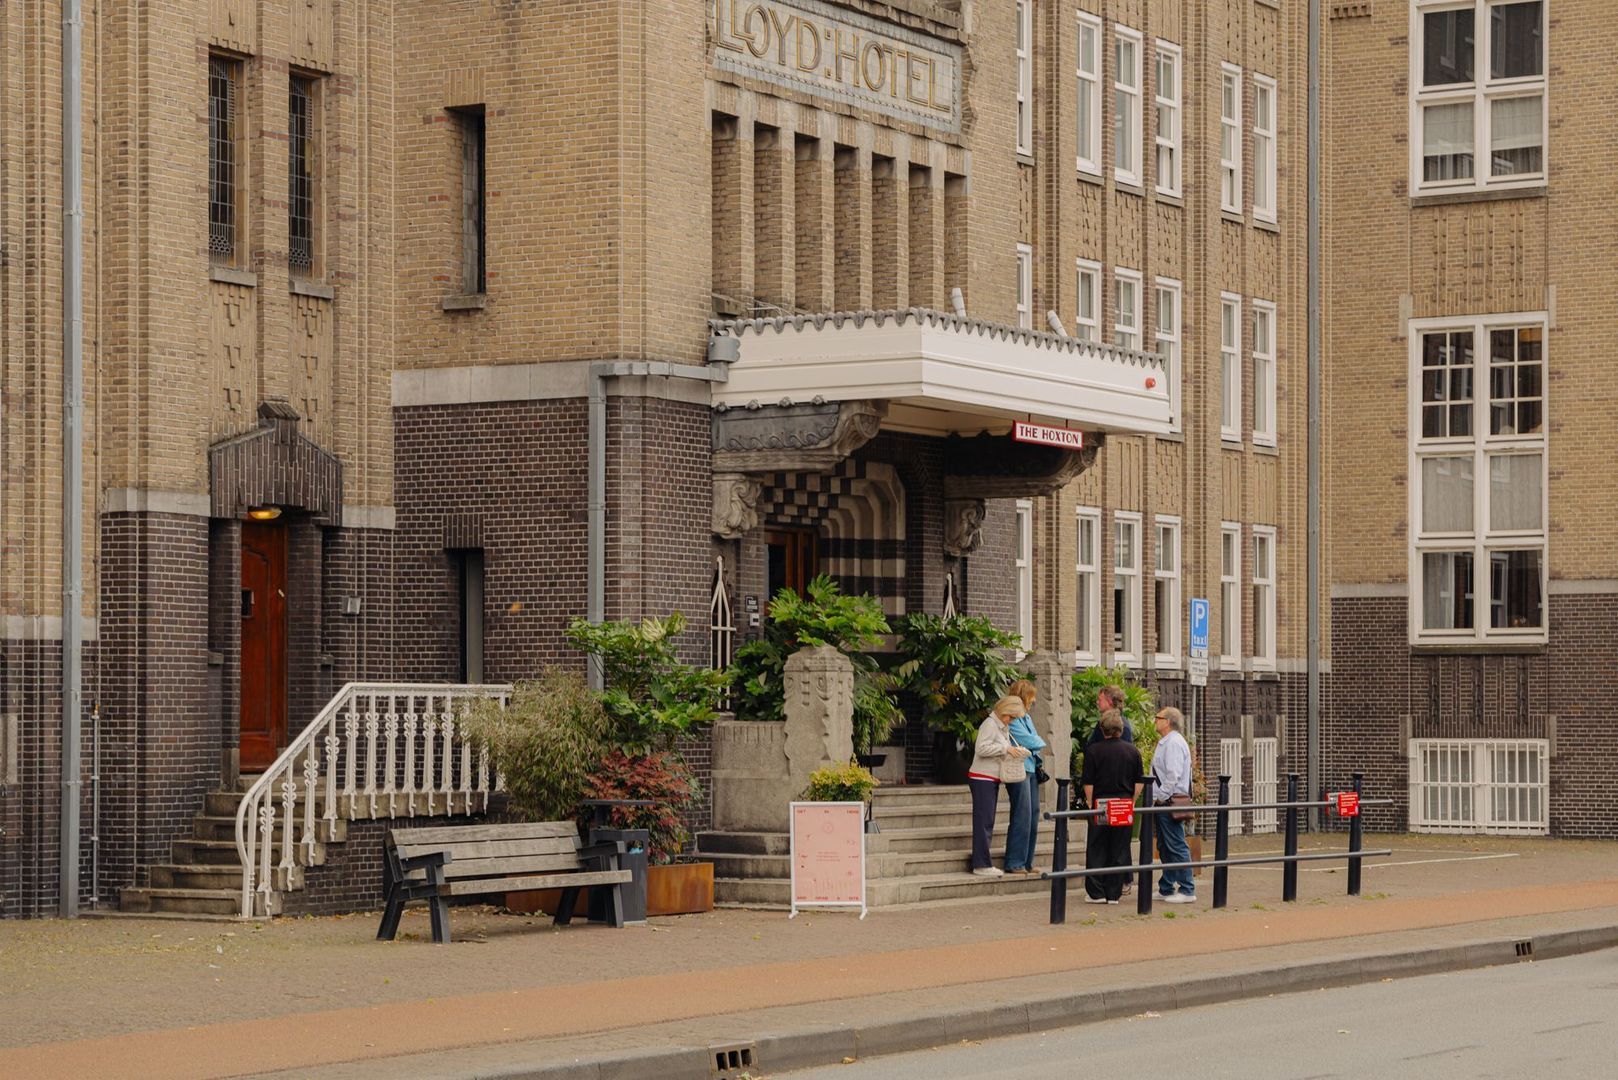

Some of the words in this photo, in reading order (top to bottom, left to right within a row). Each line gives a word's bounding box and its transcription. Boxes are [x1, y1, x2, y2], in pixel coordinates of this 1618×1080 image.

[835, 29, 951, 113] HOTEL
[1020, 426, 1038, 438] THE
[1042, 429, 1079, 444] HOXTON
[1195, 602, 1206, 628] P
[1193, 635, 1207, 645] taxi
